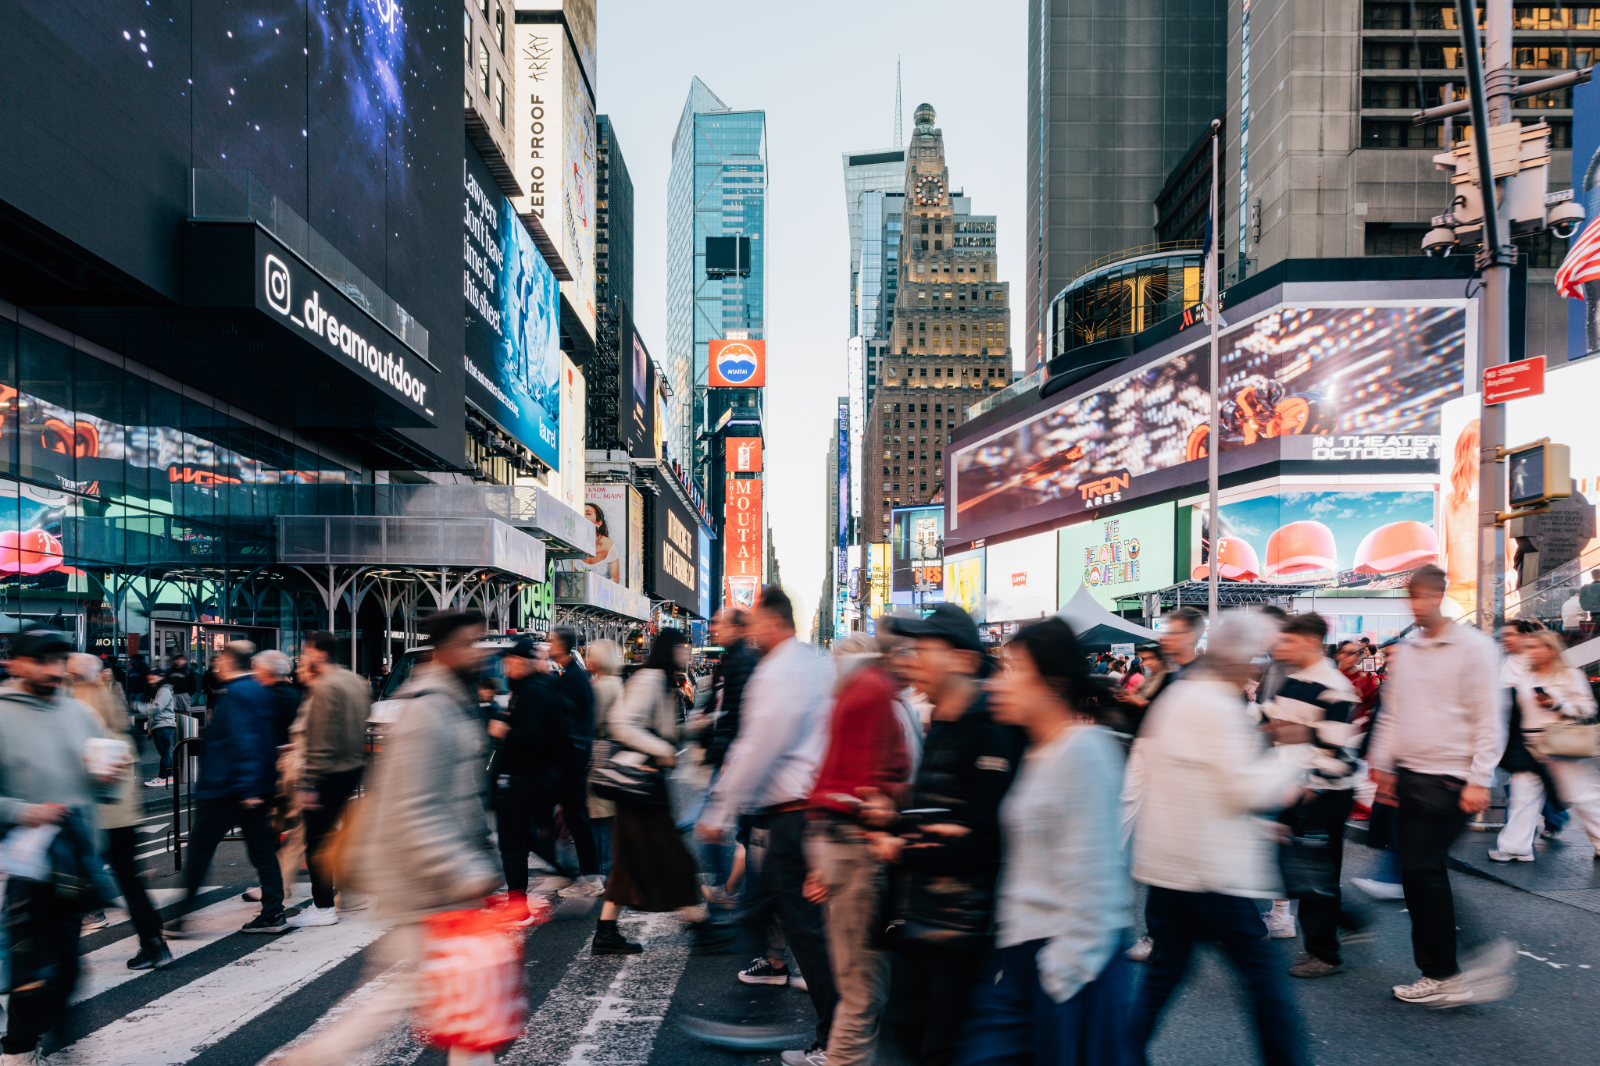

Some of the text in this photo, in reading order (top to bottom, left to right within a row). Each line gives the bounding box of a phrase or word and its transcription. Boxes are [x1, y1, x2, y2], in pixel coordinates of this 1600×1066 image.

[523, 33, 553, 219] ZERO PROOF ARKAY
[464, 158, 497, 230] Lawyers
[486, 225, 504, 272] have
[464, 232, 496, 294] time for
[464, 270, 502, 336] this sheet.
[726, 331, 748, 340] 2025
[1498, 363, 1530, 376] STANDING
[1312, 447, 1429, 460] OCTOBER
[1313, 436, 1334, 448] IN
[1078, 472, 1129, 500] TRON
[1085, 491, 1121, 508] ARES
[736, 481, 751, 573] MOUTAI
[1104, 520, 1119, 542] WE
[1085, 538, 1140, 567] BELONG TO
[1084, 560, 1140, 588] SOMETHING
